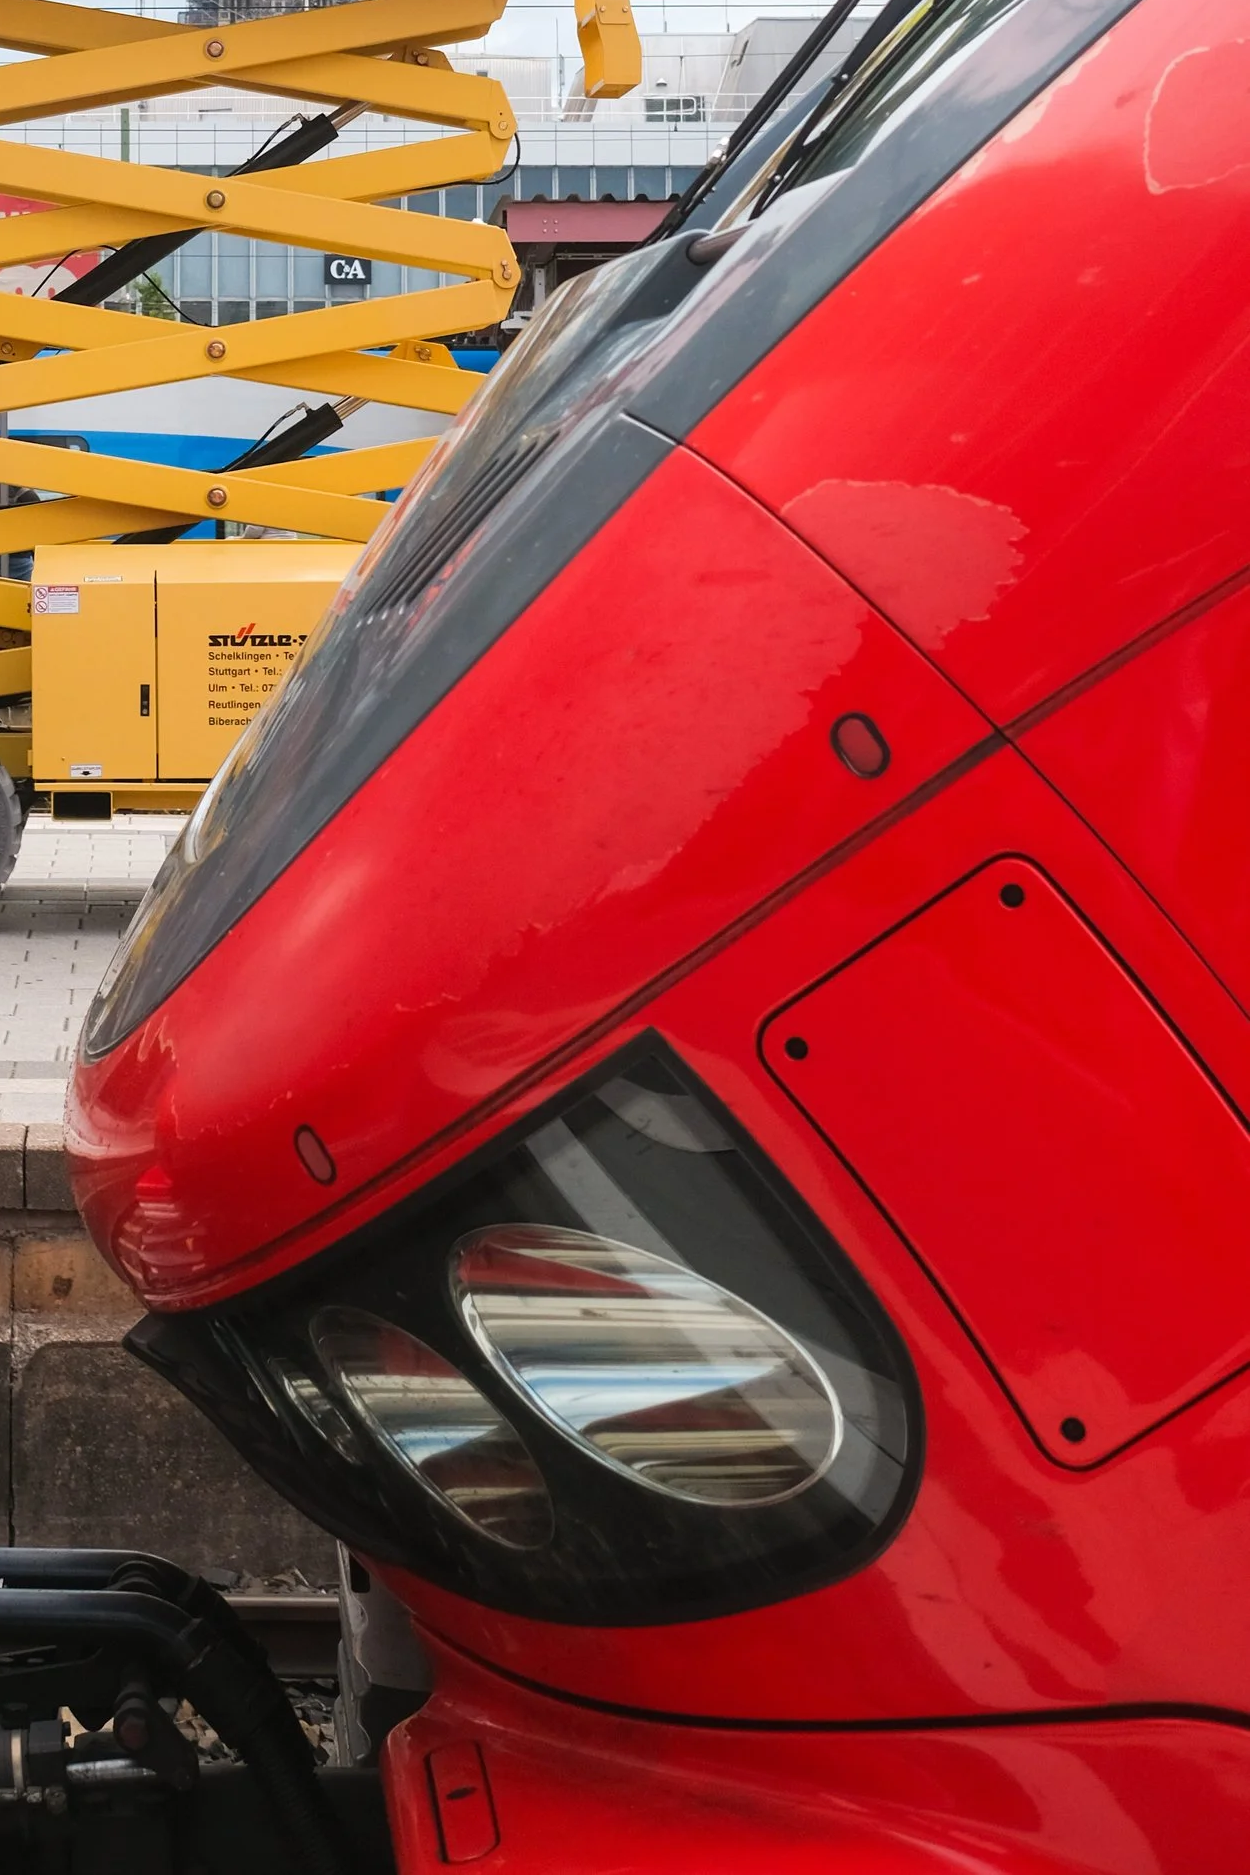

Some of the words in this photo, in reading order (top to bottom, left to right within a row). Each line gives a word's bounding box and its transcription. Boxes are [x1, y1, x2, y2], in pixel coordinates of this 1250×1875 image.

[330, 259, 366, 279] C&A
[208, 651, 271, 662] Schelklingen
[283, 651, 297, 661] Te
[208, 667, 251, 677] Stuttgart
[262, 667, 282, 676] Tel.:
[208, 683, 228, 692] Ulm
[239, 683, 259, 693] Tel.:
[261, 683, 276, 693] 07
[208, 700, 261, 711] Reutlingen
